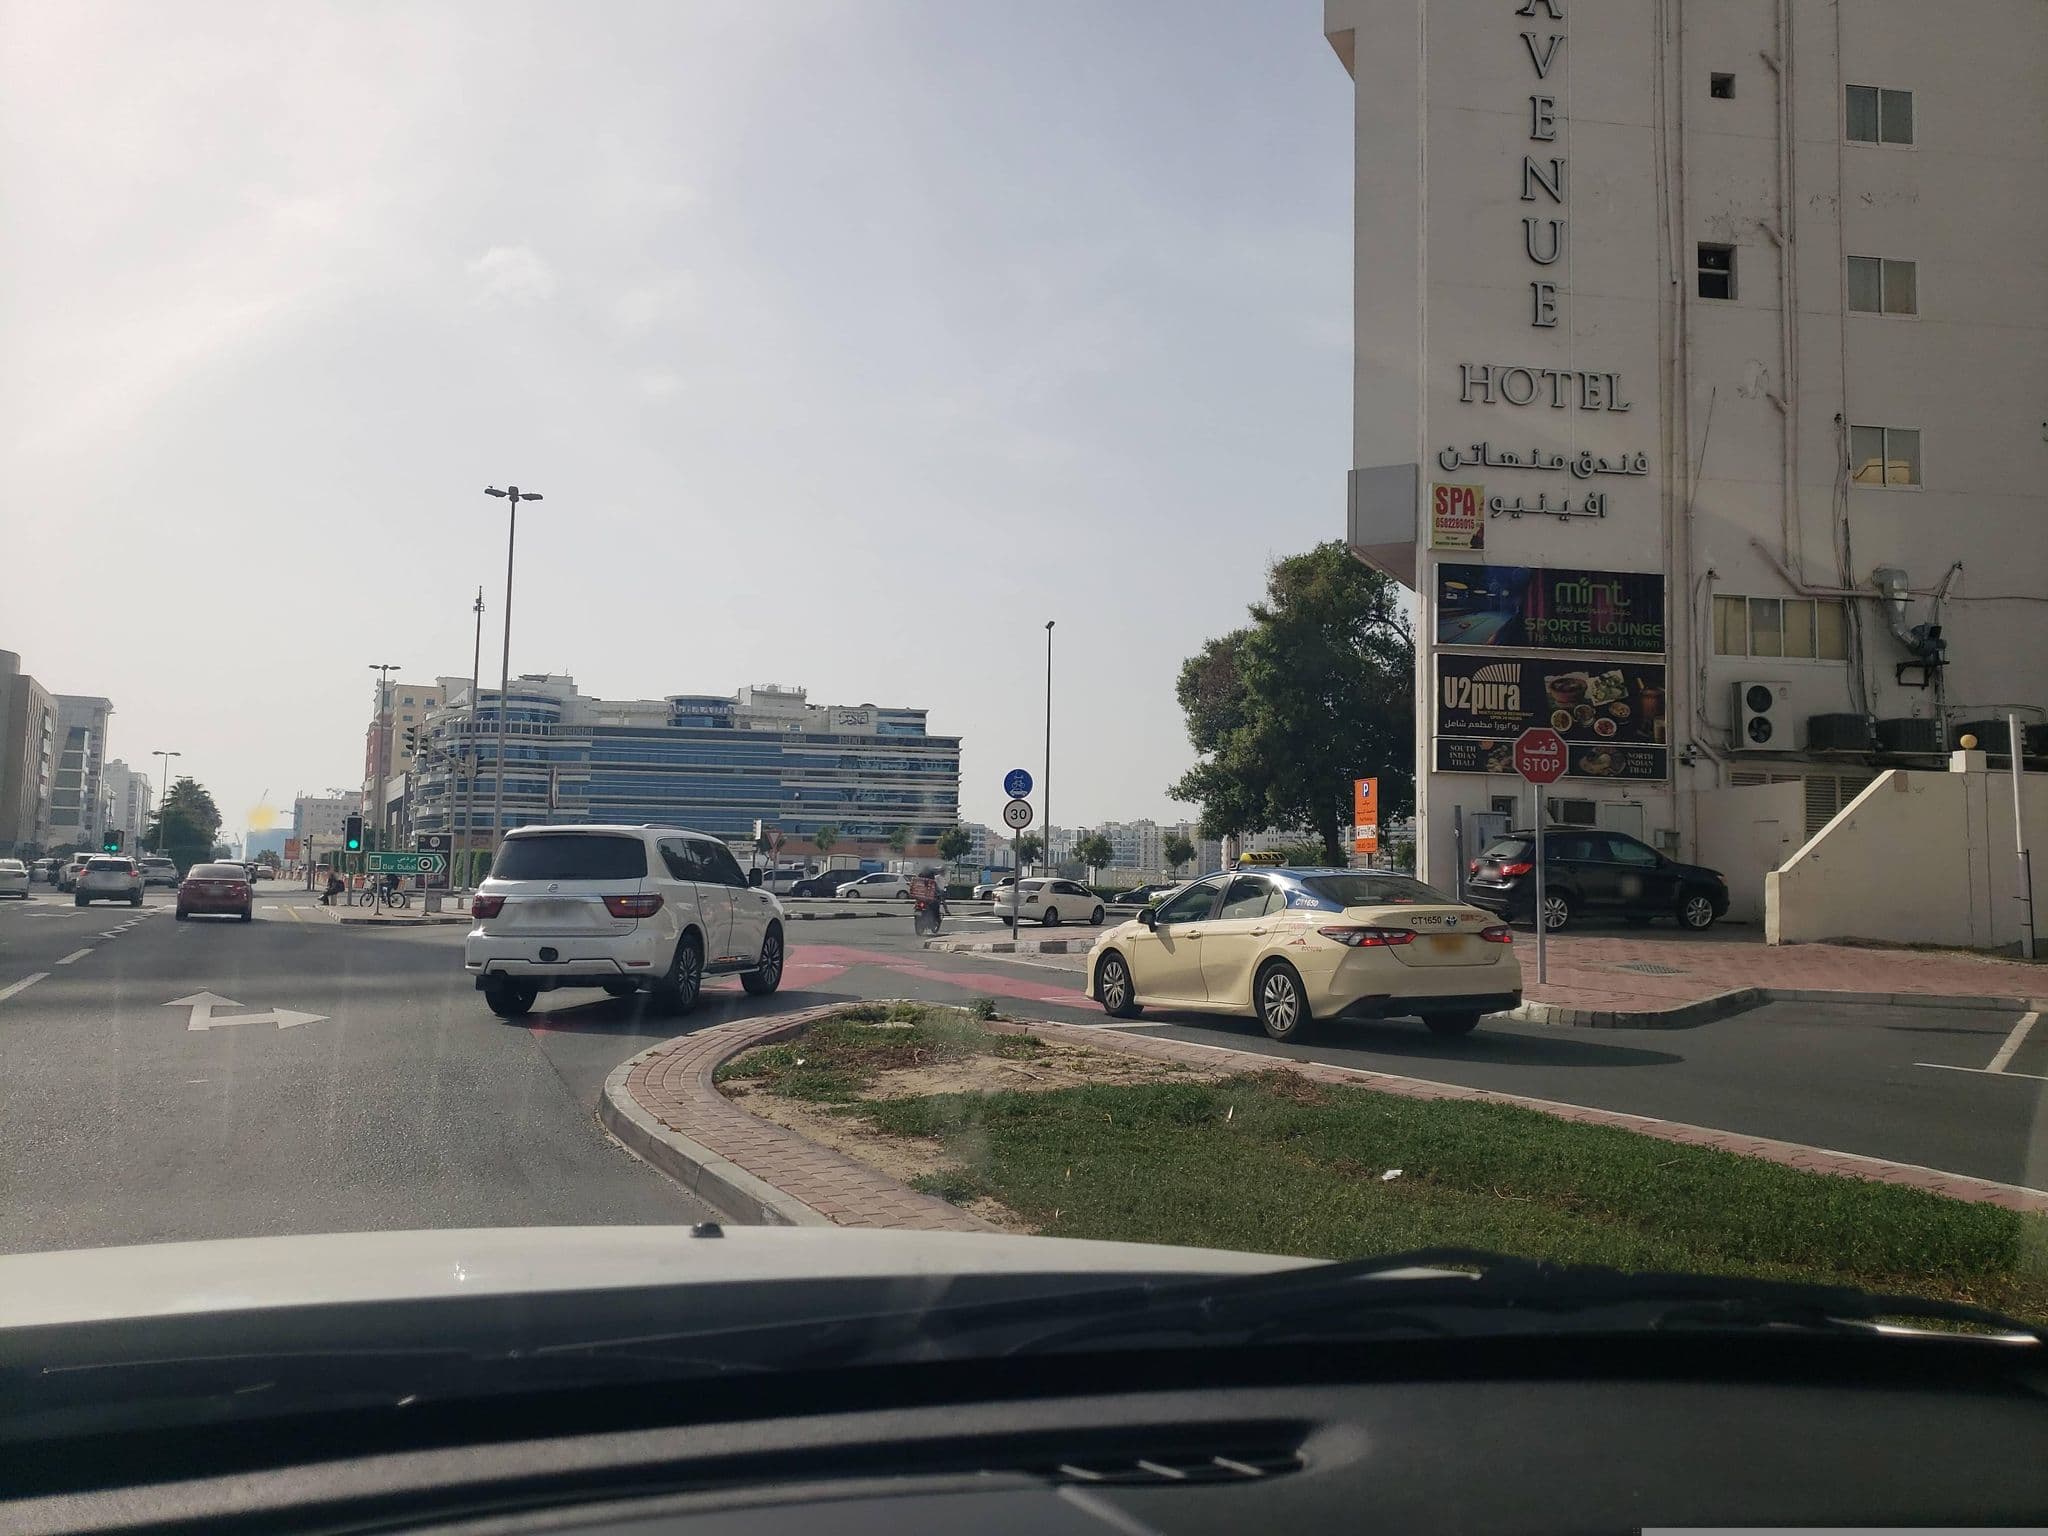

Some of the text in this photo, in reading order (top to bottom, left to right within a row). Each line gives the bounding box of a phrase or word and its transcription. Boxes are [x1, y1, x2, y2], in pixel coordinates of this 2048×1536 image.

[1459, 362, 1630, 412] HOTEL
[1570, 451, 1649, 479] فندق
[1436, 486, 1476, 516] SPA
[1555, 577, 1631, 606] mint
[1524, 618, 1663, 637] SPORTS LOUNGE
[1551, 633, 1577, 644] Most
[1632, 638, 1661, 649] Town
[1444, 676, 1520, 715] U2pura
[1449, 744, 1476, 753] SOUTH
[1523, 738, 1558, 755] قف
[1449, 752, 1477, 760] INDIAN
[1628, 752, 1654, 760] NORTH
[1522, 757, 1560, 772] STOP
[1363, 783, 1369, 797] P
[1010, 808, 1027, 820] 30
[1253, 852, 1282, 860] TAXI
[397, 863, 417, 871] Dubai
[1295, 898, 1319, 907] CT1650
[1411, 916, 1442, 925] CT1650
